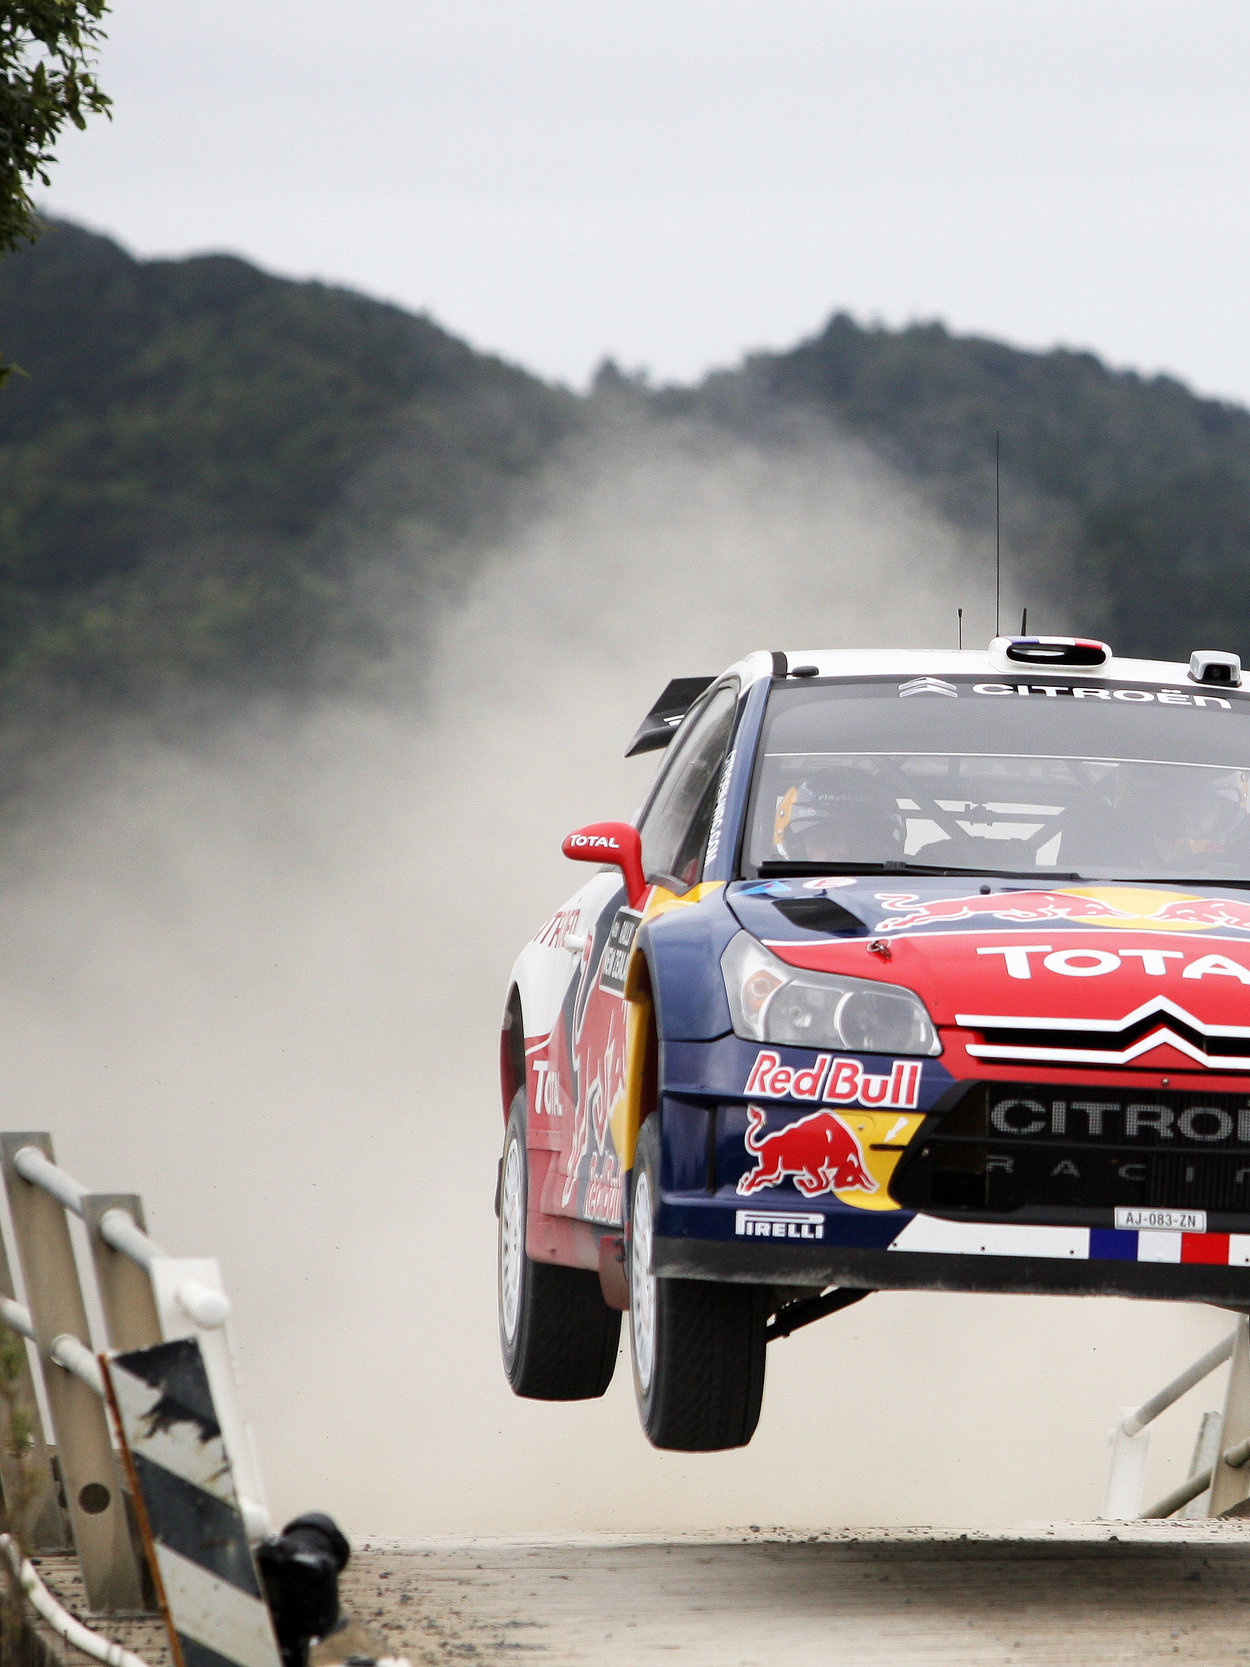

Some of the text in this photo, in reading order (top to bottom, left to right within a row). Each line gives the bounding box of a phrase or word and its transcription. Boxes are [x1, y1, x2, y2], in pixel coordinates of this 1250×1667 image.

[570, 834, 620, 848] TOTAL
[744, 1050, 922, 1108] Red Bull
[735, 1210, 825, 1239] PIRELLI
[1125, 1212, 1196, 1228] AJ-083-ZN
